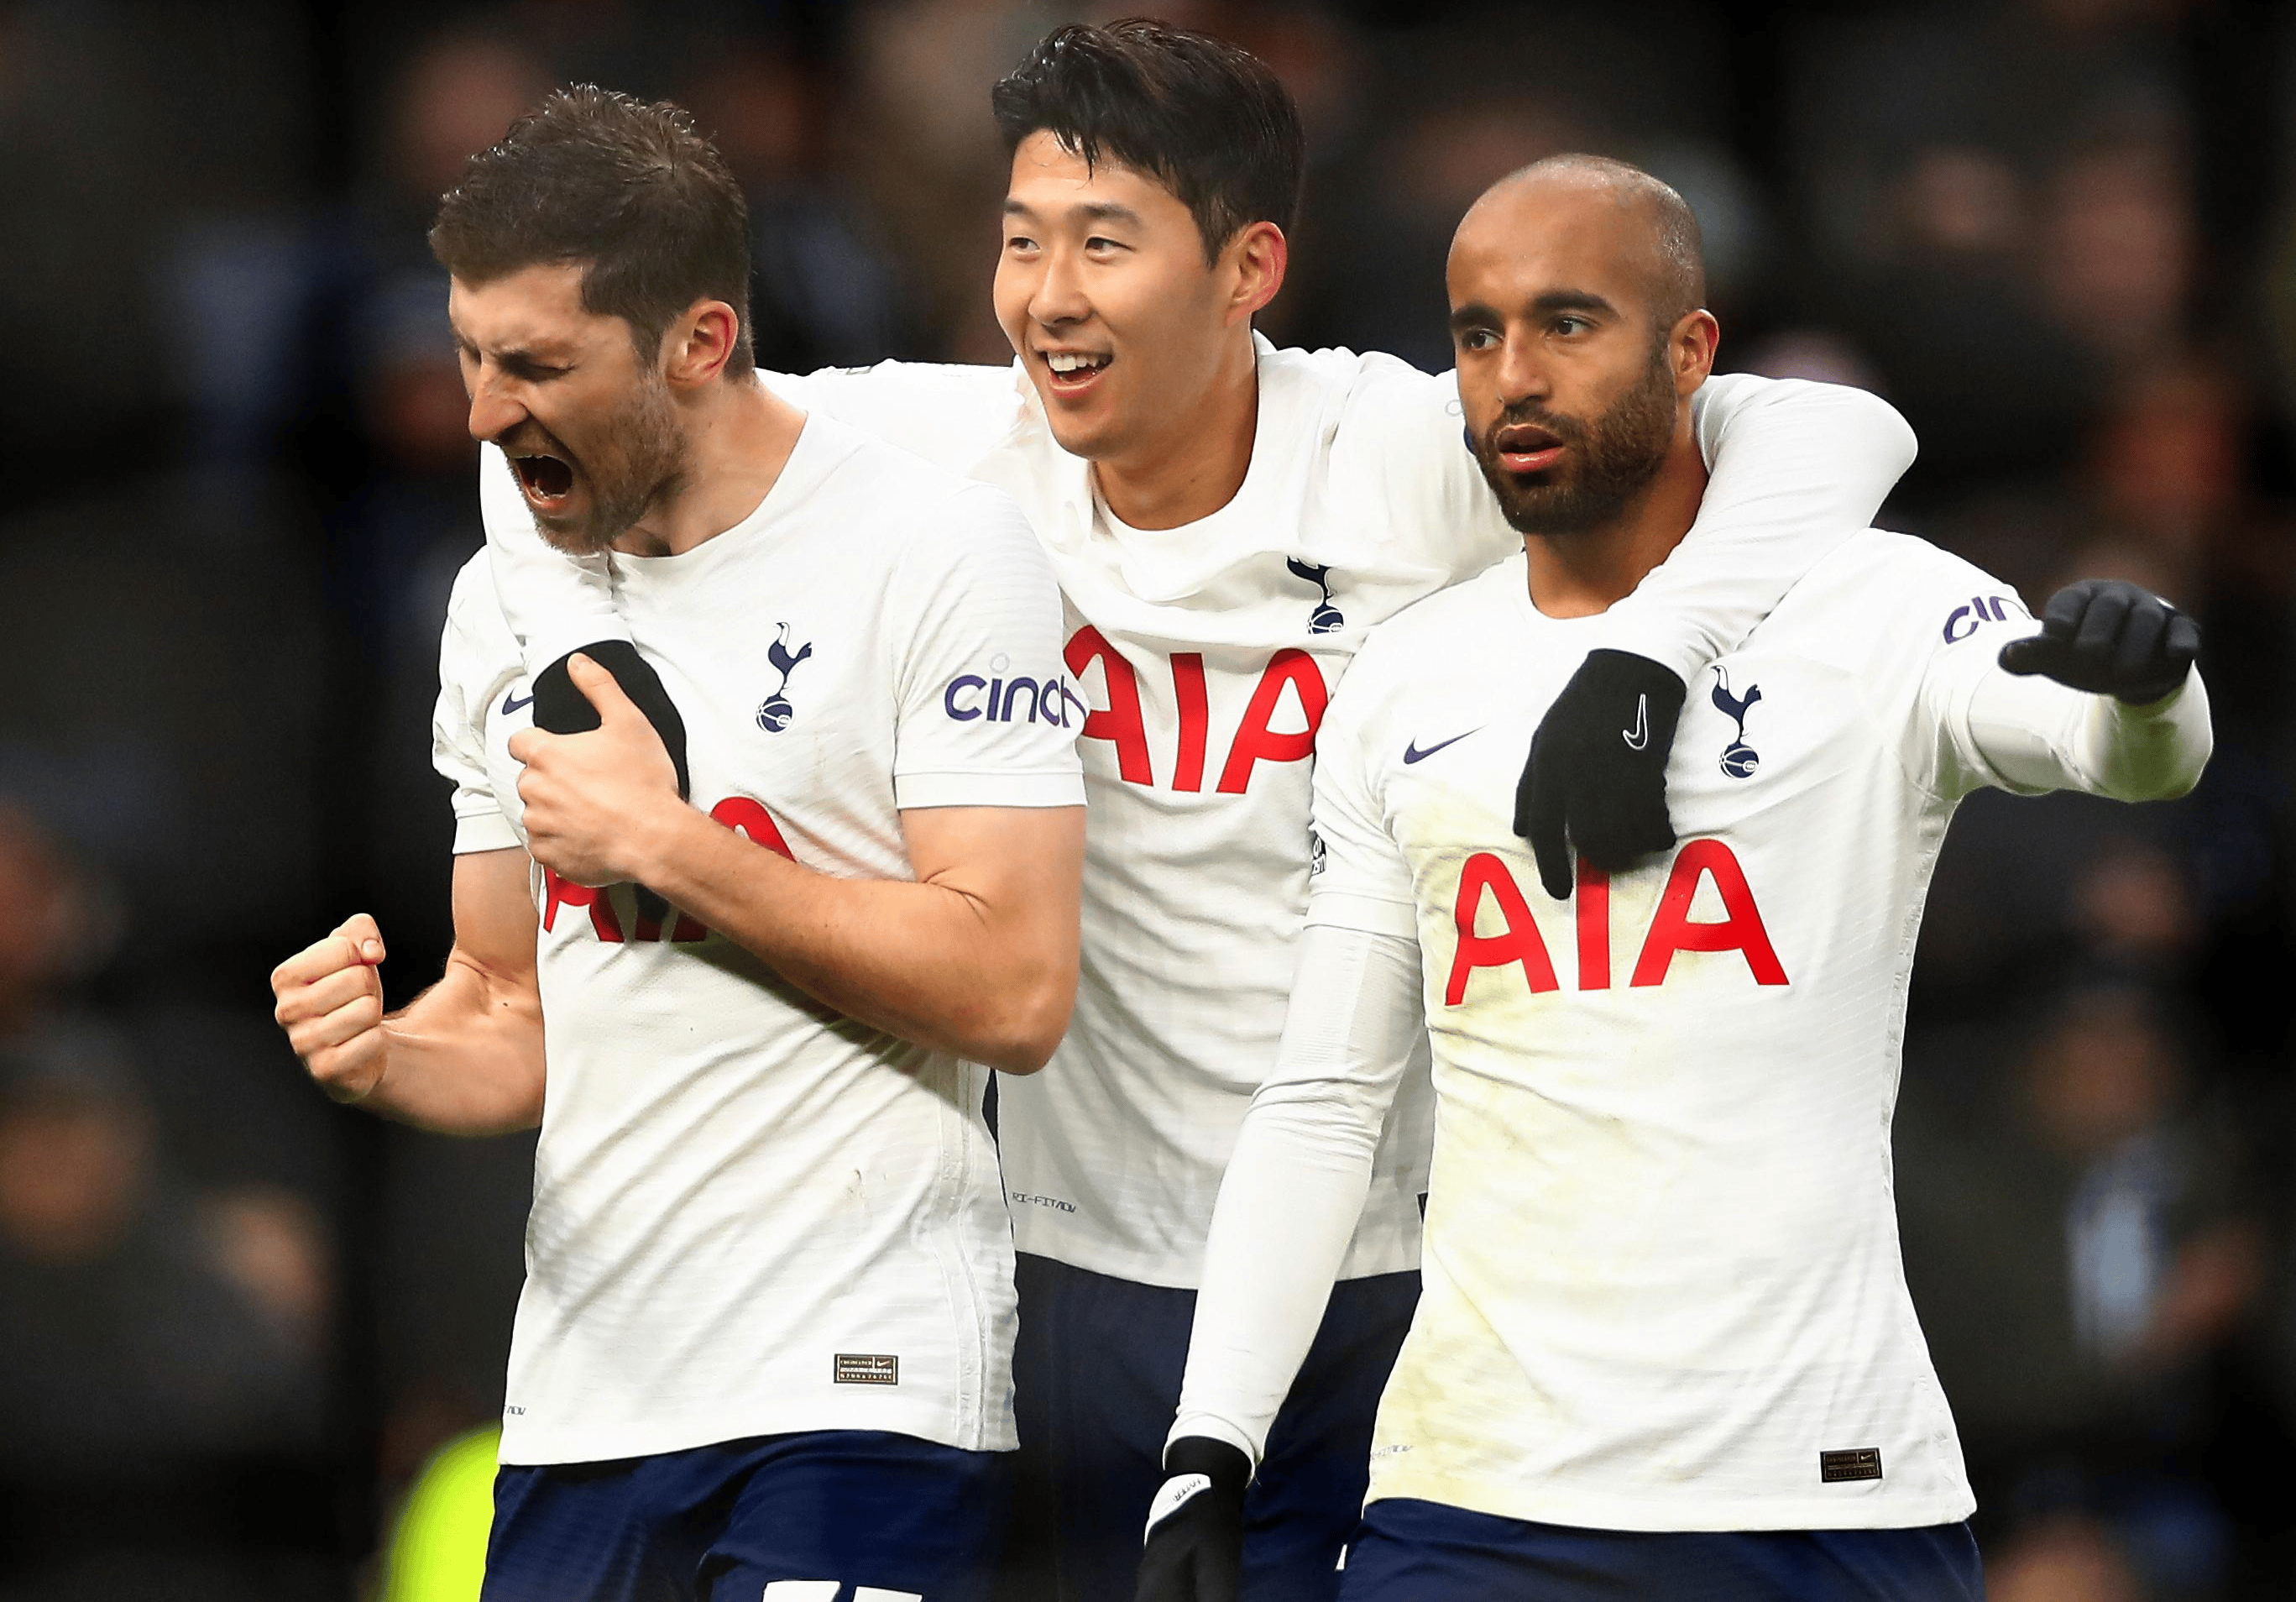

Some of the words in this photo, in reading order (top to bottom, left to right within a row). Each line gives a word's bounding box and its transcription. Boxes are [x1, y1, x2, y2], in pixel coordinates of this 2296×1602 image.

[1943, 595, 2032, 645] cin
[944, 674, 1087, 728] cinch
[1063, 624, 1329, 794] AIA
[1445, 839, 1790, 1007] AIA
